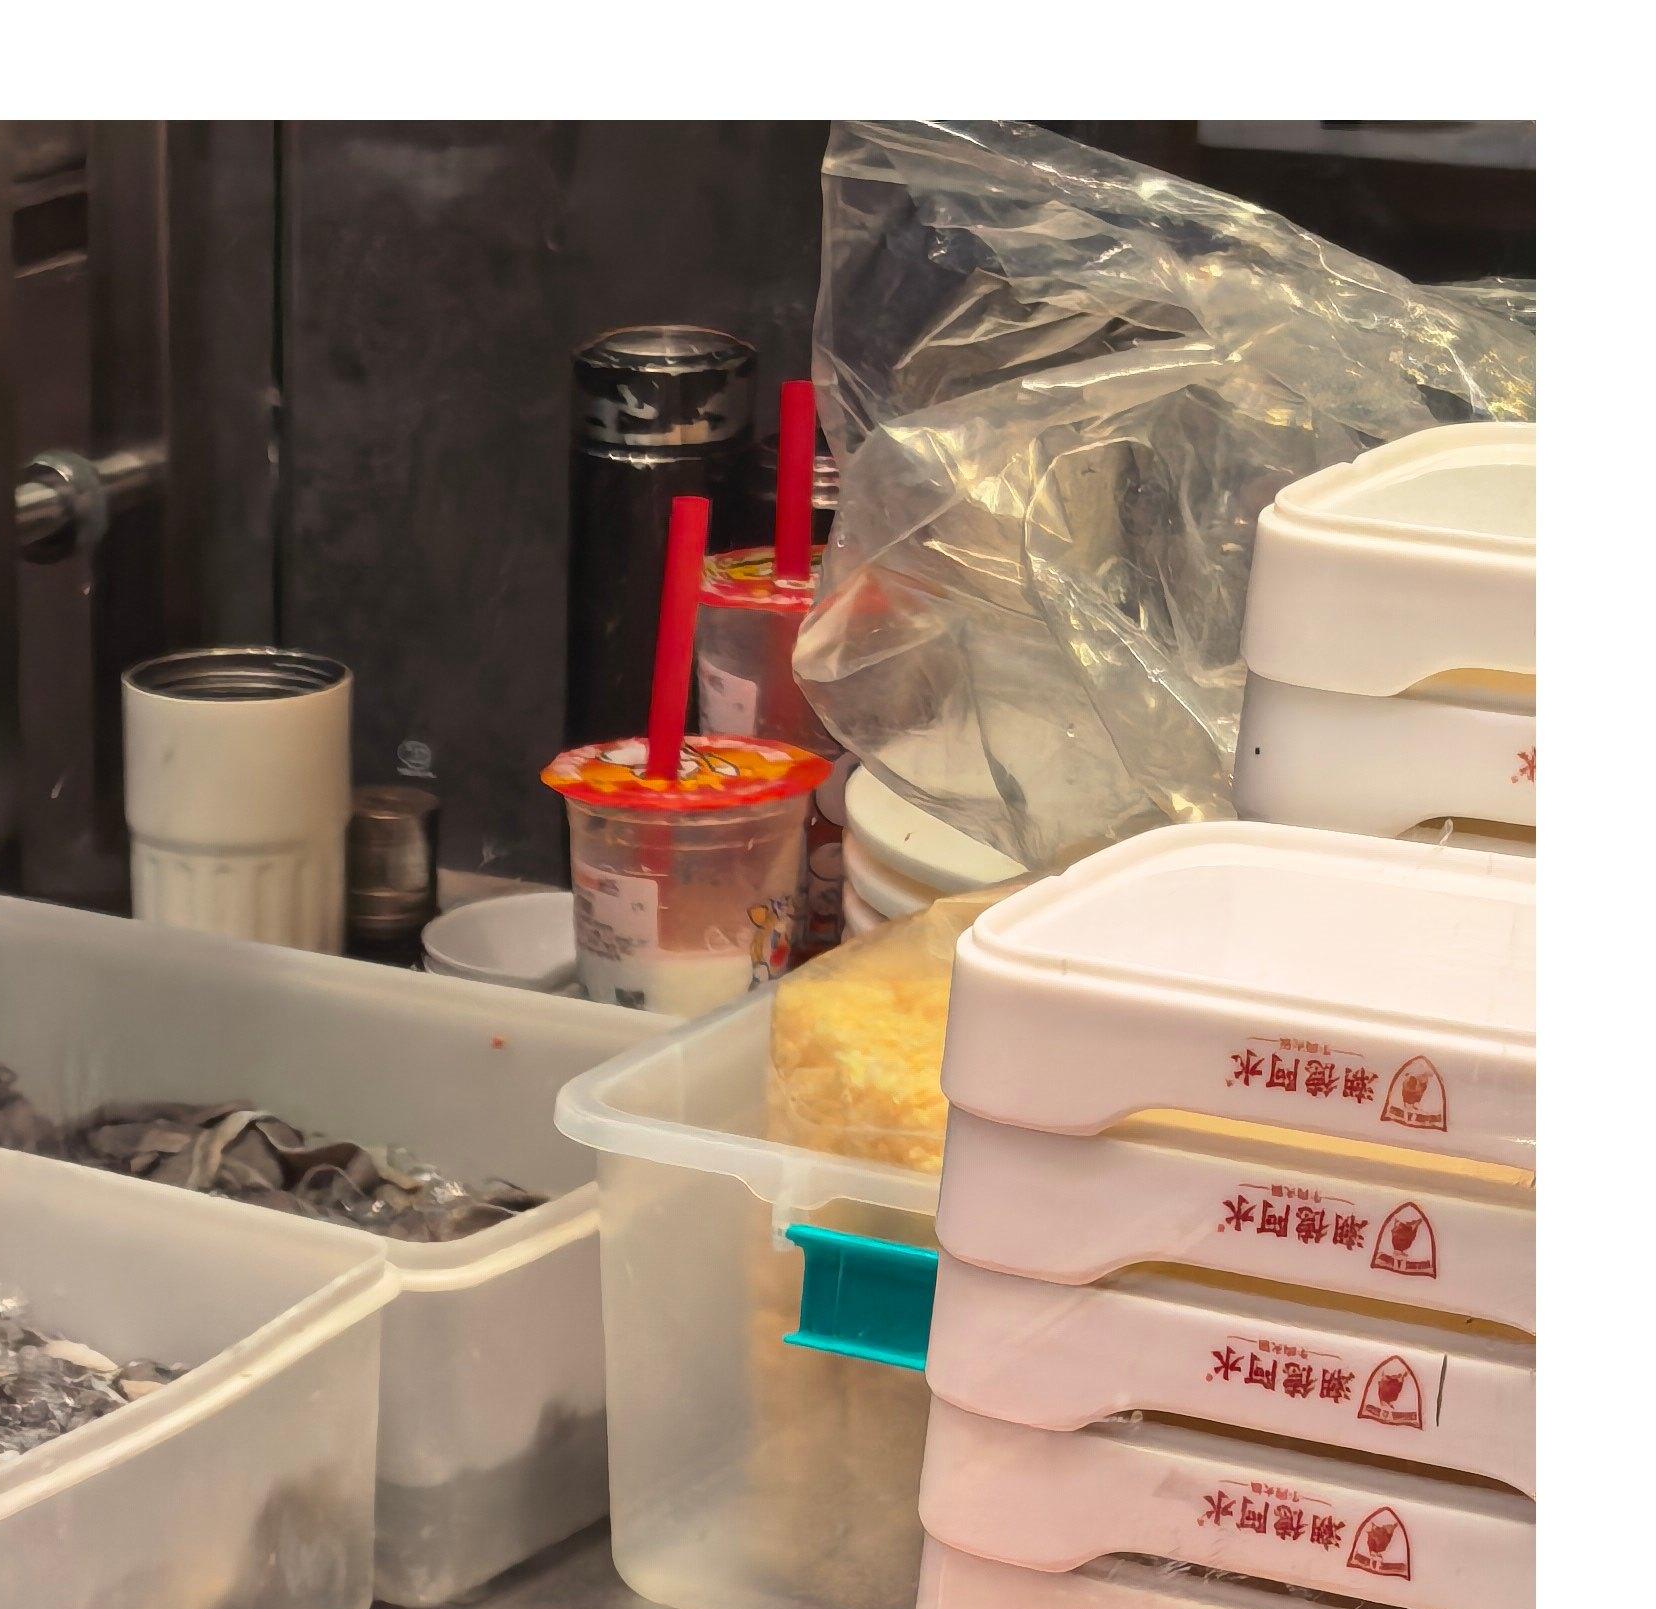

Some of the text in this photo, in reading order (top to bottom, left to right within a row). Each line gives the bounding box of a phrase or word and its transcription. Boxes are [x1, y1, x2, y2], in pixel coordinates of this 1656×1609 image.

[1231, 1049, 1378, 1104] 潮德阿水
[1222, 1195, 1368, 1251] 潮德阿水
[1211, 1347, 1355, 1403] 潮德阿水
[1204, 1491, 1345, 1550] 潮德阿水
